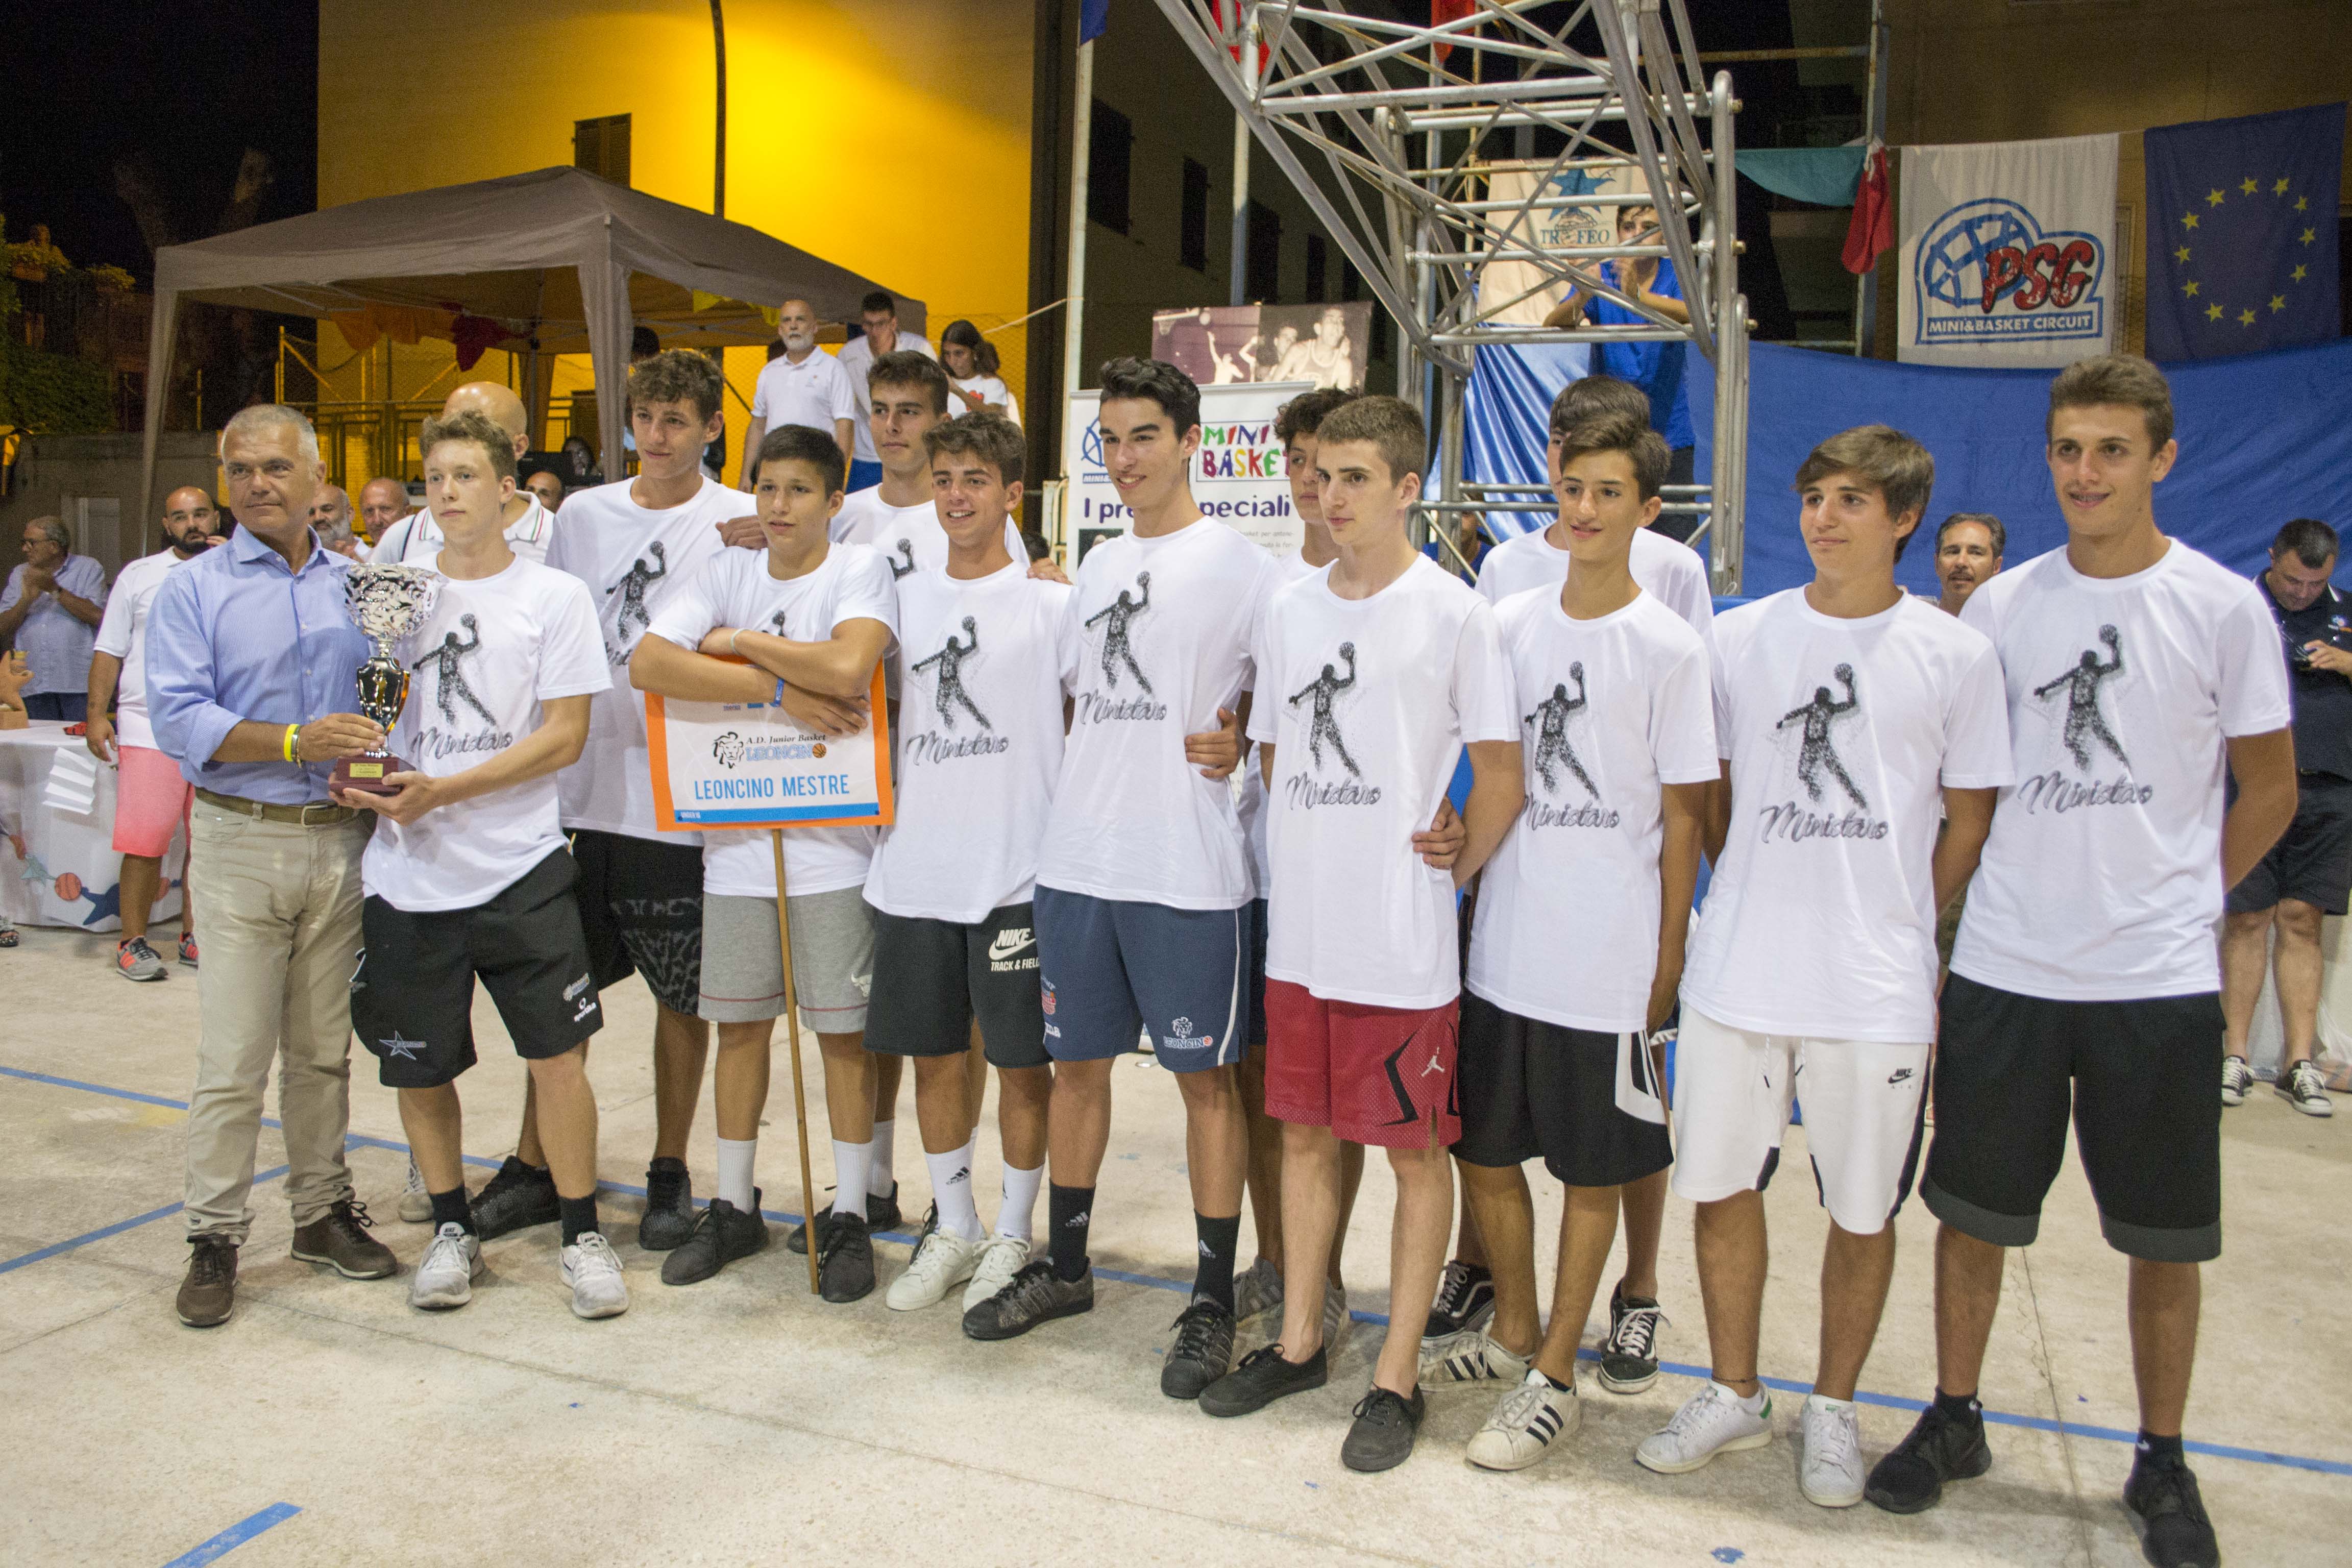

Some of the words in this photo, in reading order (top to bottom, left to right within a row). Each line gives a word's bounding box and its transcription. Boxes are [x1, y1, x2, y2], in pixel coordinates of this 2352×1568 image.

[1982, 240, 2095, 313] PSG
[2033, 315, 2091, 330] CIRCUIT
[1203, 424, 1270, 446] MINI
[1084, 497, 1090, 518] I
[1199, 495, 1290, 517] peciali
[769, 735, 795, 744] Junior
[798, 733, 826, 742] Basket
[694, 777, 774, 800] LEONCINO
[781, 774, 850, 797] MESTRE
[2017, 770, 2153, 815] Ministas
[995, 927, 1031, 947] NIKE
[991, 961, 1014, 972] TRACK
[1014, 959, 1021, 970] &
